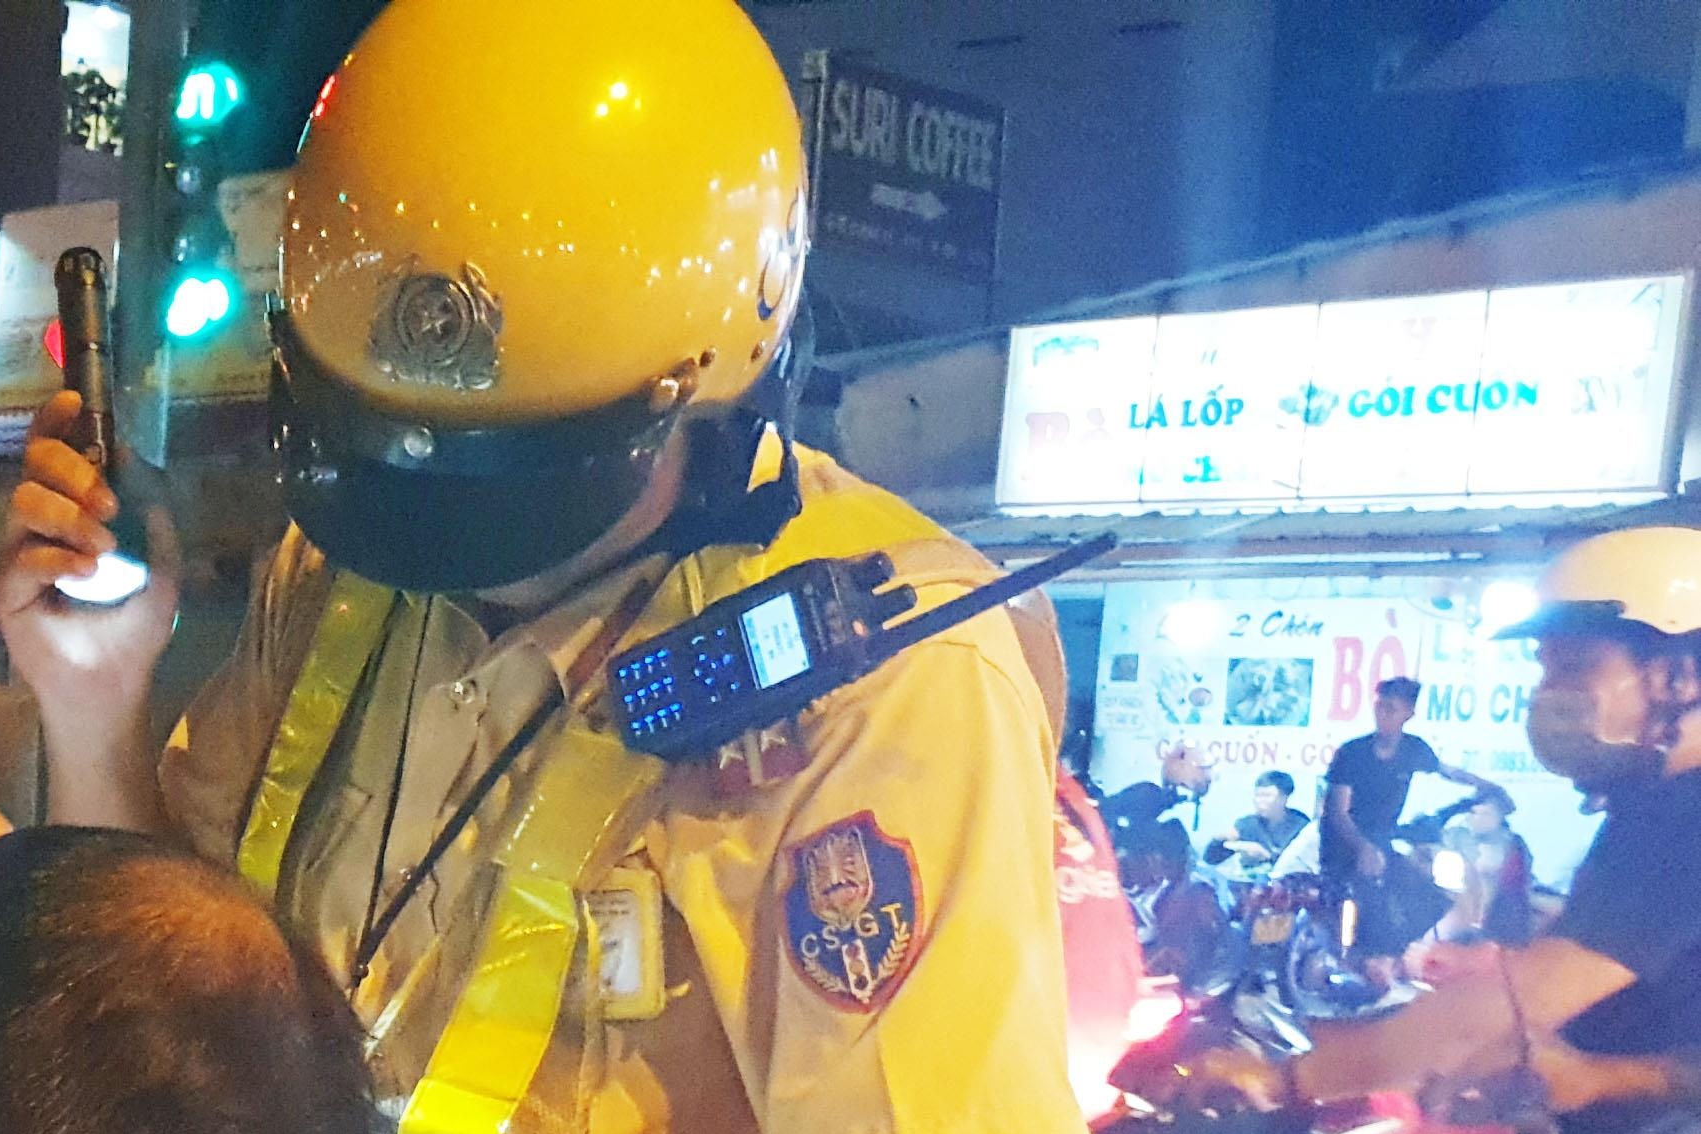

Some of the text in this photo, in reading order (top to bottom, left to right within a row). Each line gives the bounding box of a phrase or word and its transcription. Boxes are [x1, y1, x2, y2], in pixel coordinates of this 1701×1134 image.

[906, 100, 996, 191] COFFEE
[1180, 383, 1245, 427] LỐP
[801, 902, 903, 958] CSGT
